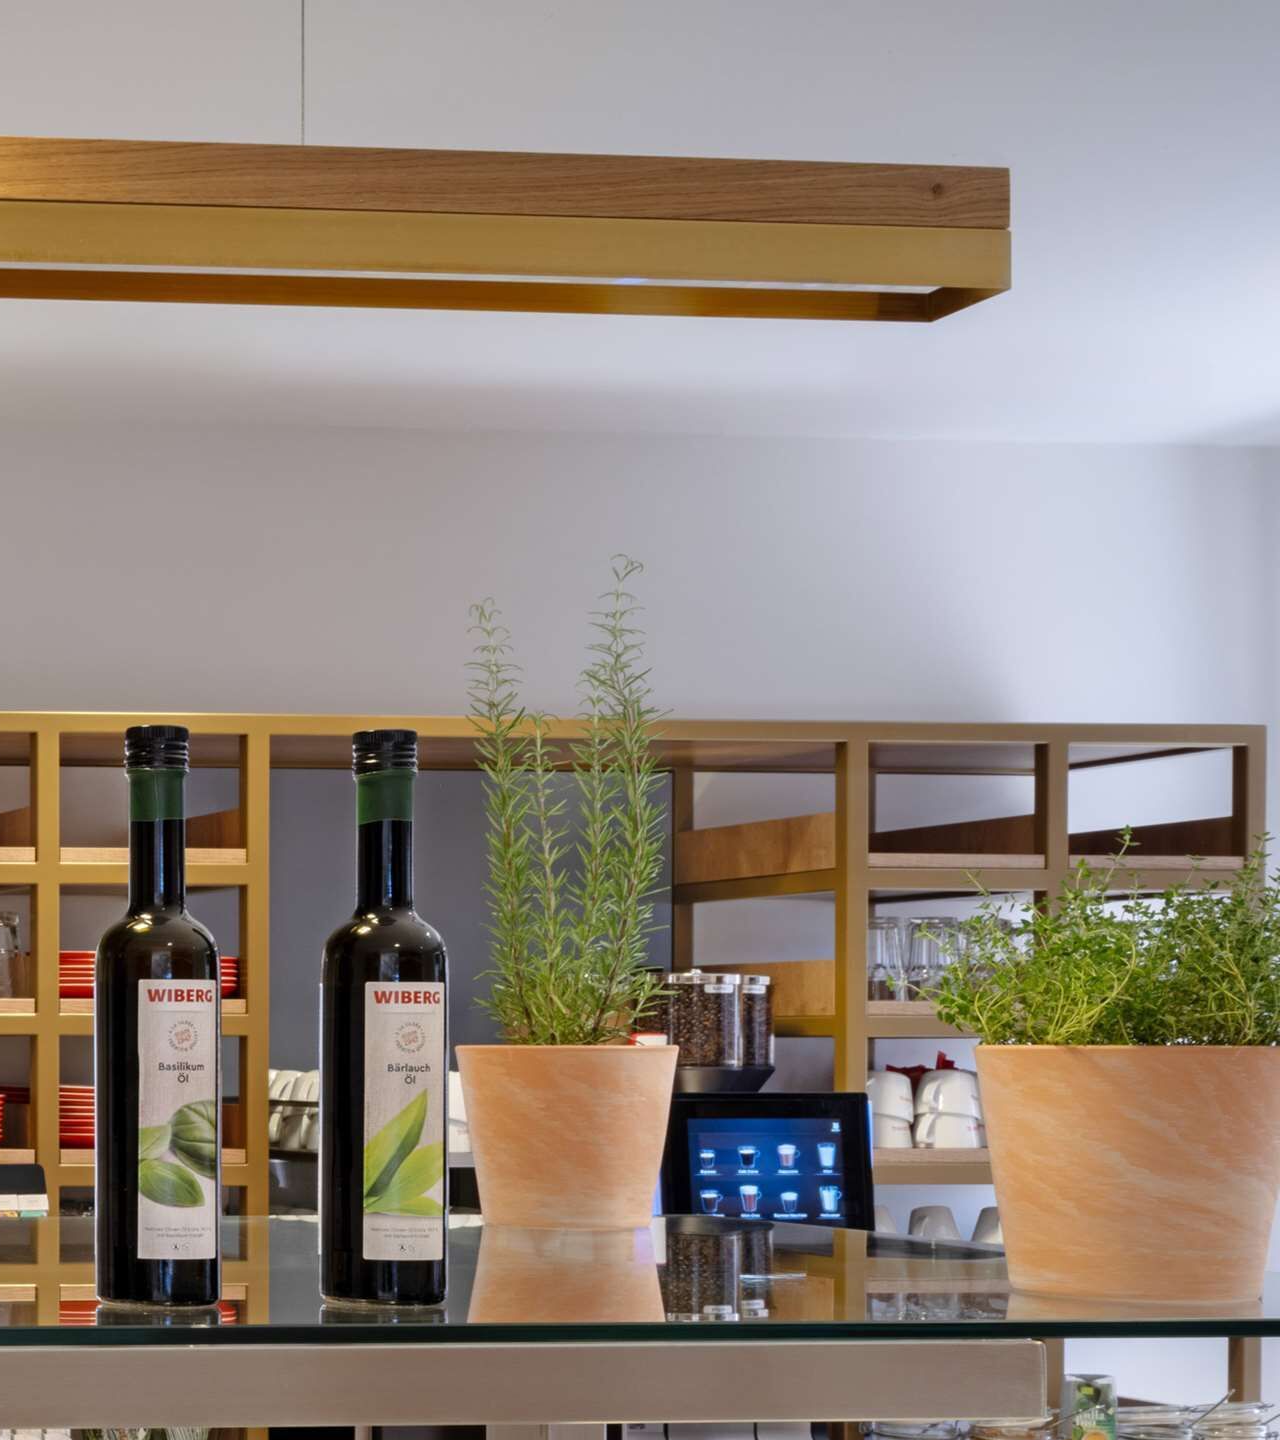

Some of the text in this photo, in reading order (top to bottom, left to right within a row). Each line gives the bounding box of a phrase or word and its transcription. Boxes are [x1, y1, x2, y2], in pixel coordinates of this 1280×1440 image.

[147, 988, 213, 1003] WIBERG
[374, 990, 440, 1004] WIBERG
[158, 1061, 205, 1071] Basilikum
[387, 1063, 431, 1073] Bärlauch
[177, 1072, 189, 1084] Öl
[404, 1074, 416, 1085] Öl
